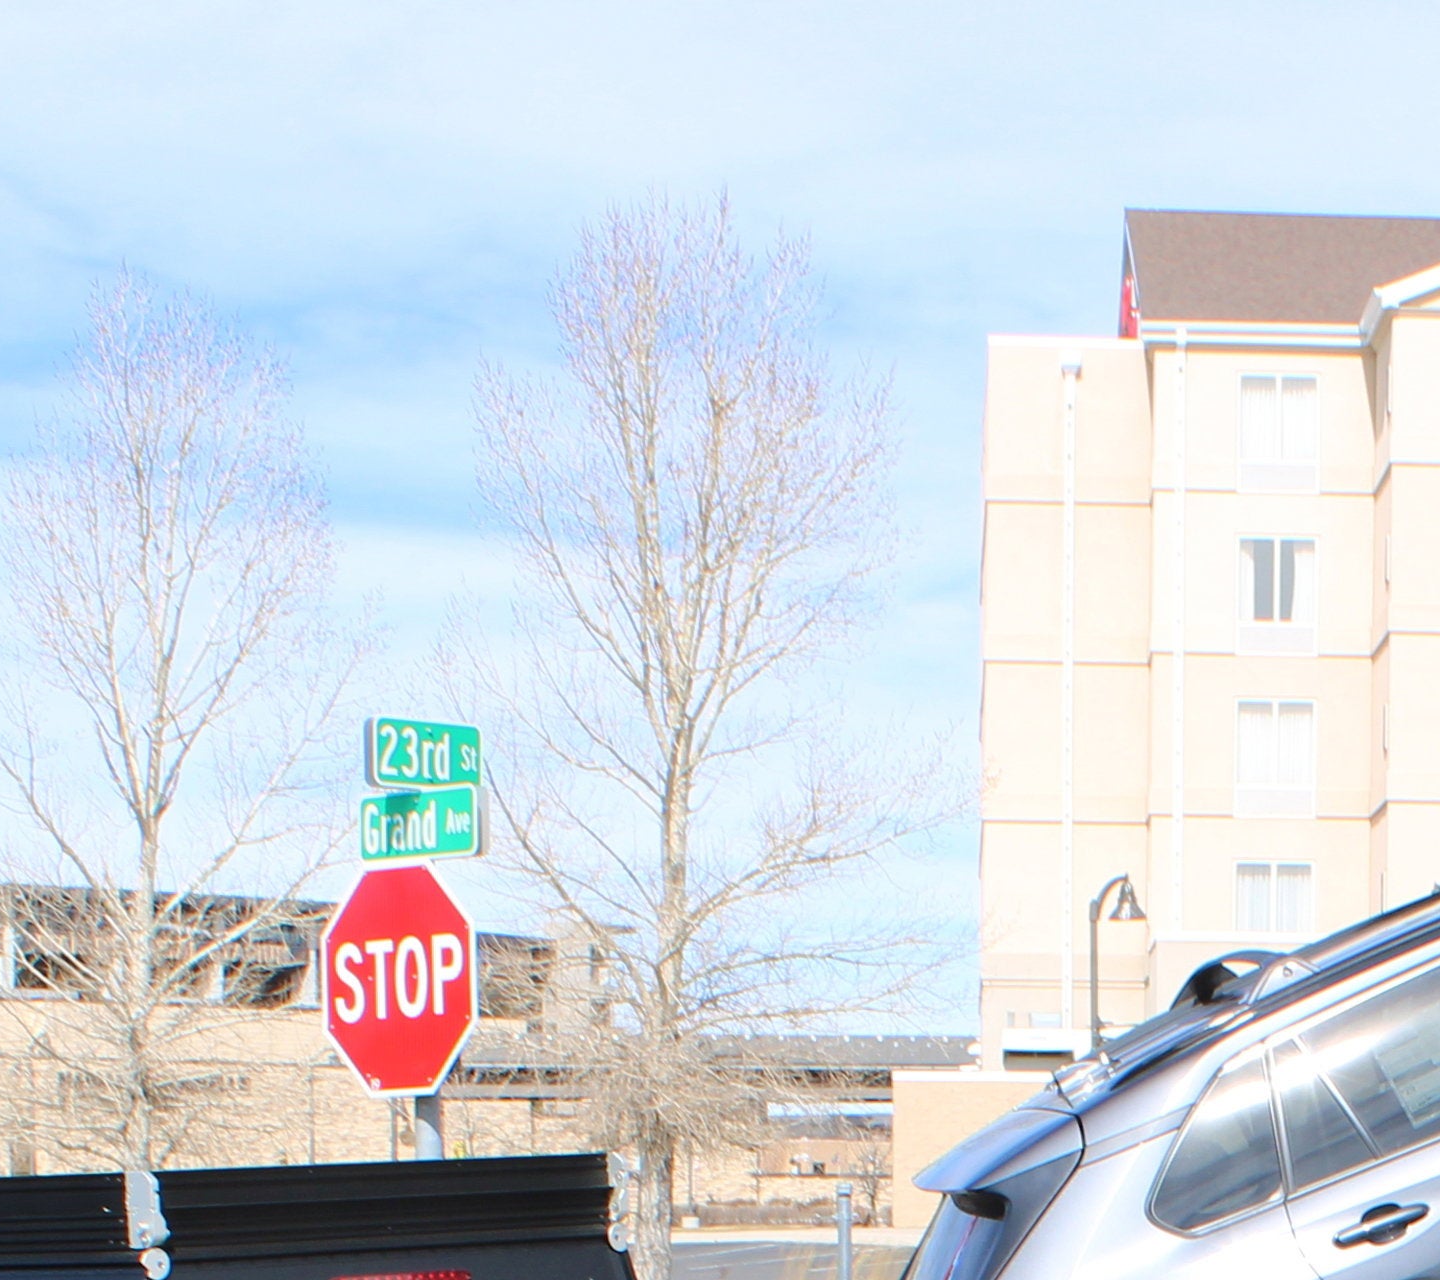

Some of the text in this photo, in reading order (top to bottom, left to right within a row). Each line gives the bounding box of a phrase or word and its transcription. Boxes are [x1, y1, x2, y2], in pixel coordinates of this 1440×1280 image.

[379, 723, 479, 783] 23rd St
[363, 799, 472, 856] Grand Ave
[334, 932, 464, 1026] STOP
